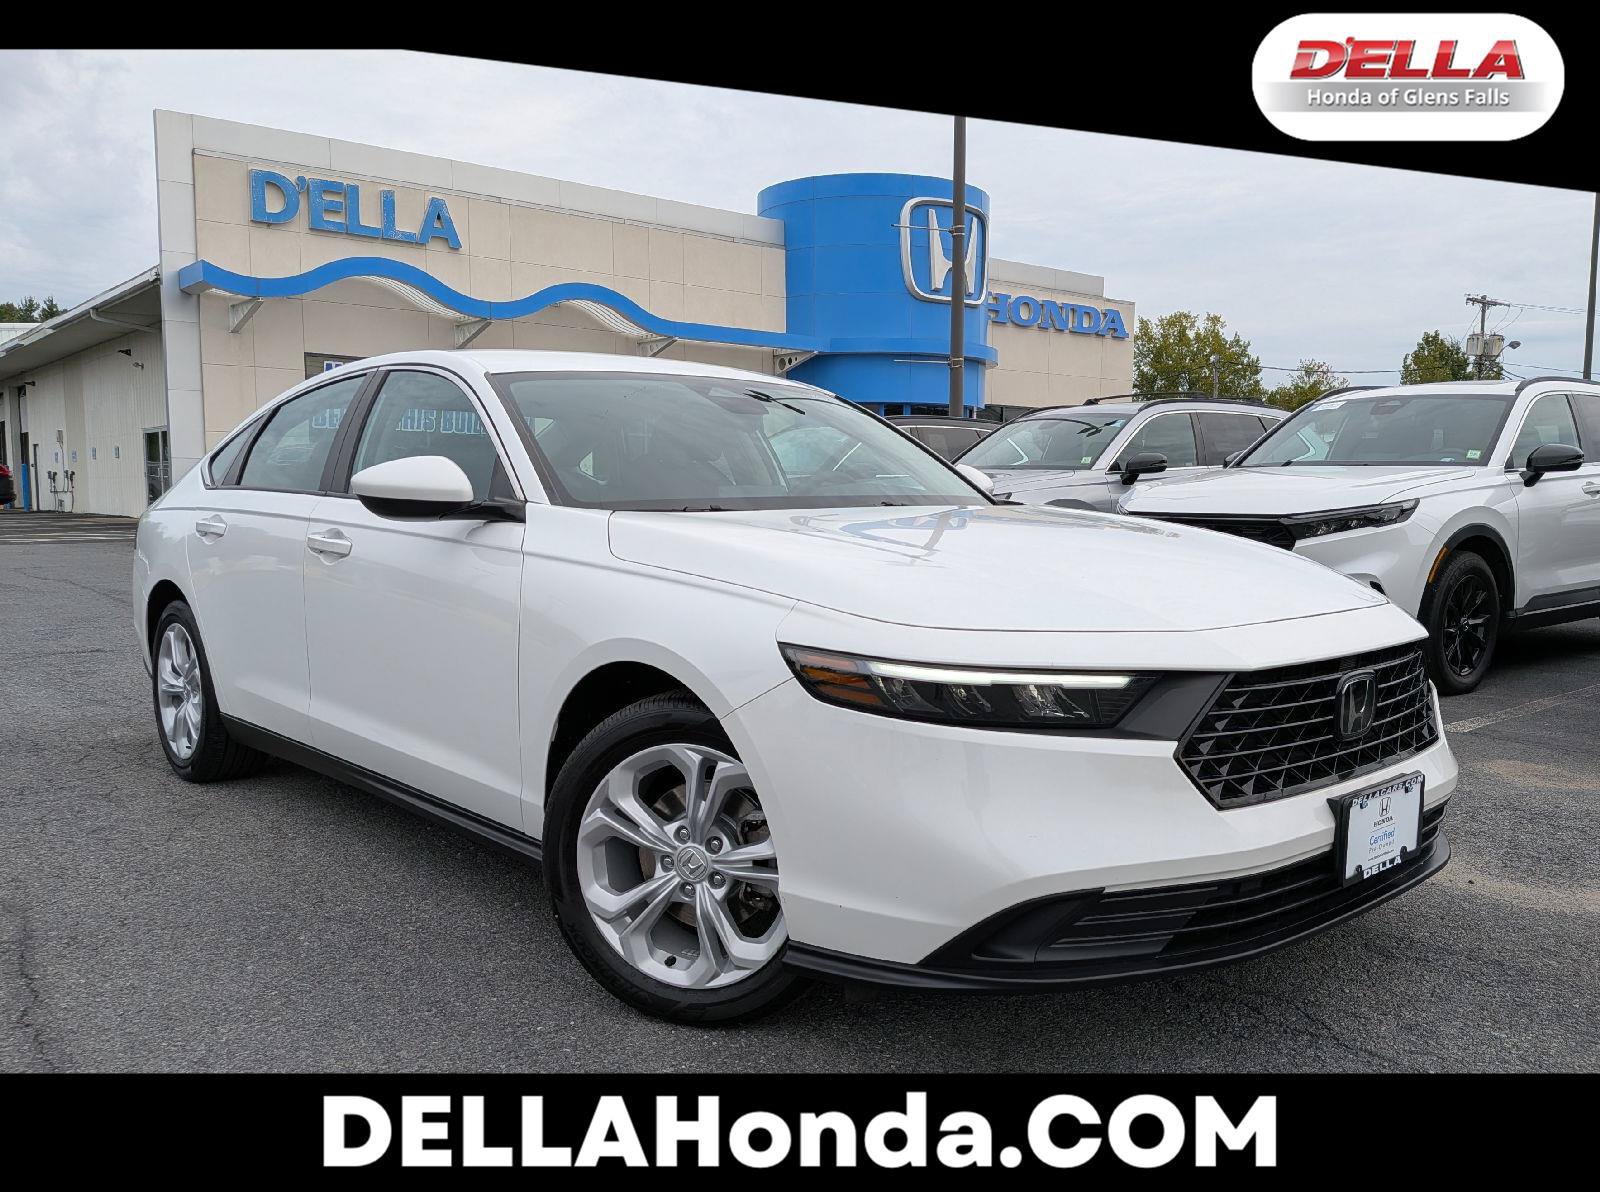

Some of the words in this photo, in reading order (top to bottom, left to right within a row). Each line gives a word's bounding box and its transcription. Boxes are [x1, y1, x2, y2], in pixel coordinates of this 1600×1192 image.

[249, 168, 463, 250] D'ELLA
[987, 290, 1130, 339] HONDA
[1369, 827, 1396, 846] Certified
[1363, 855, 1401, 879] DELLA
